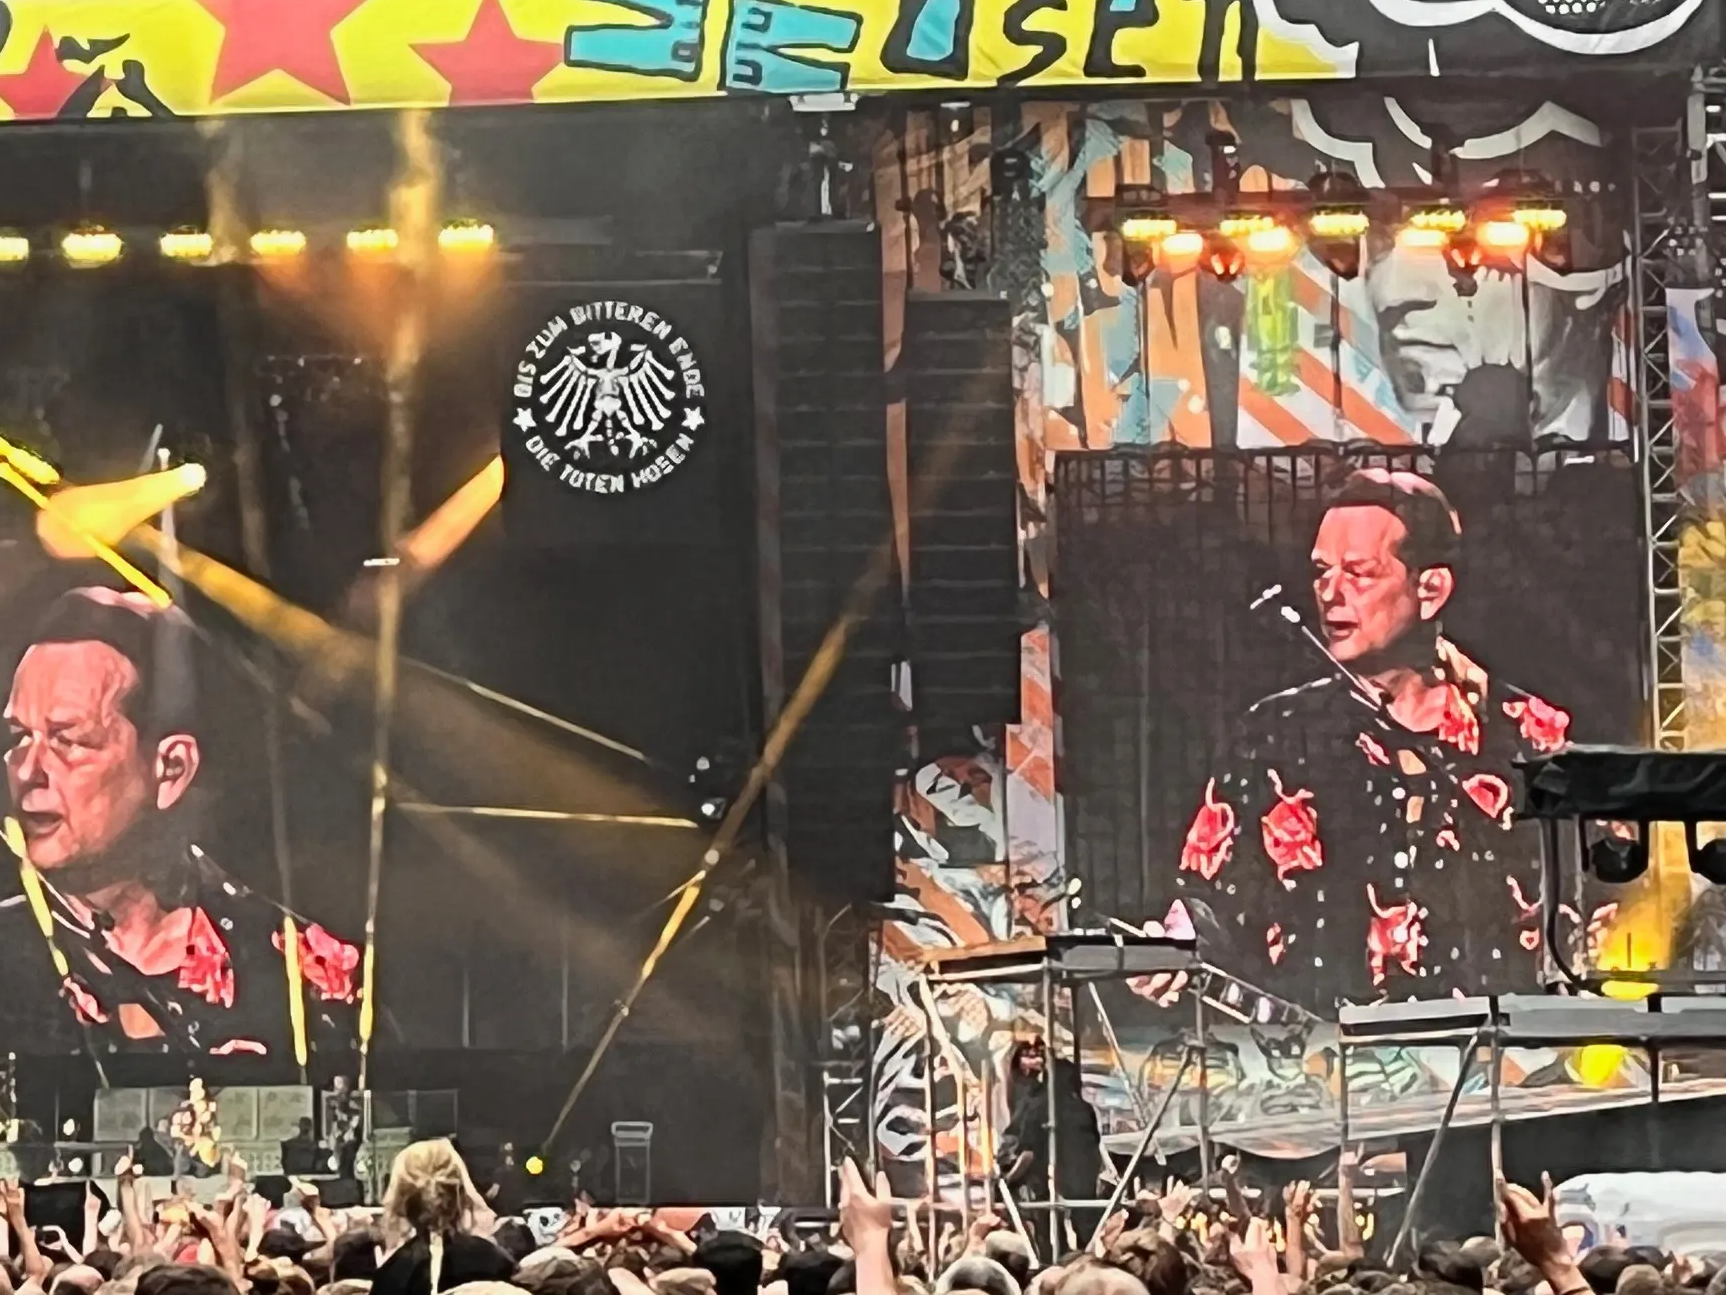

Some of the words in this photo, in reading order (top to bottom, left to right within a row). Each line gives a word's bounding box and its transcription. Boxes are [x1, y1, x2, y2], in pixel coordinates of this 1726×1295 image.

[525, 315, 568, 359] ZUM
[668, 336, 705, 399] ENDE
[525, 435, 561, 472] DIE
[559, 463, 625, 494] TOTEN
[630, 433, 694, 488] HOSEN
